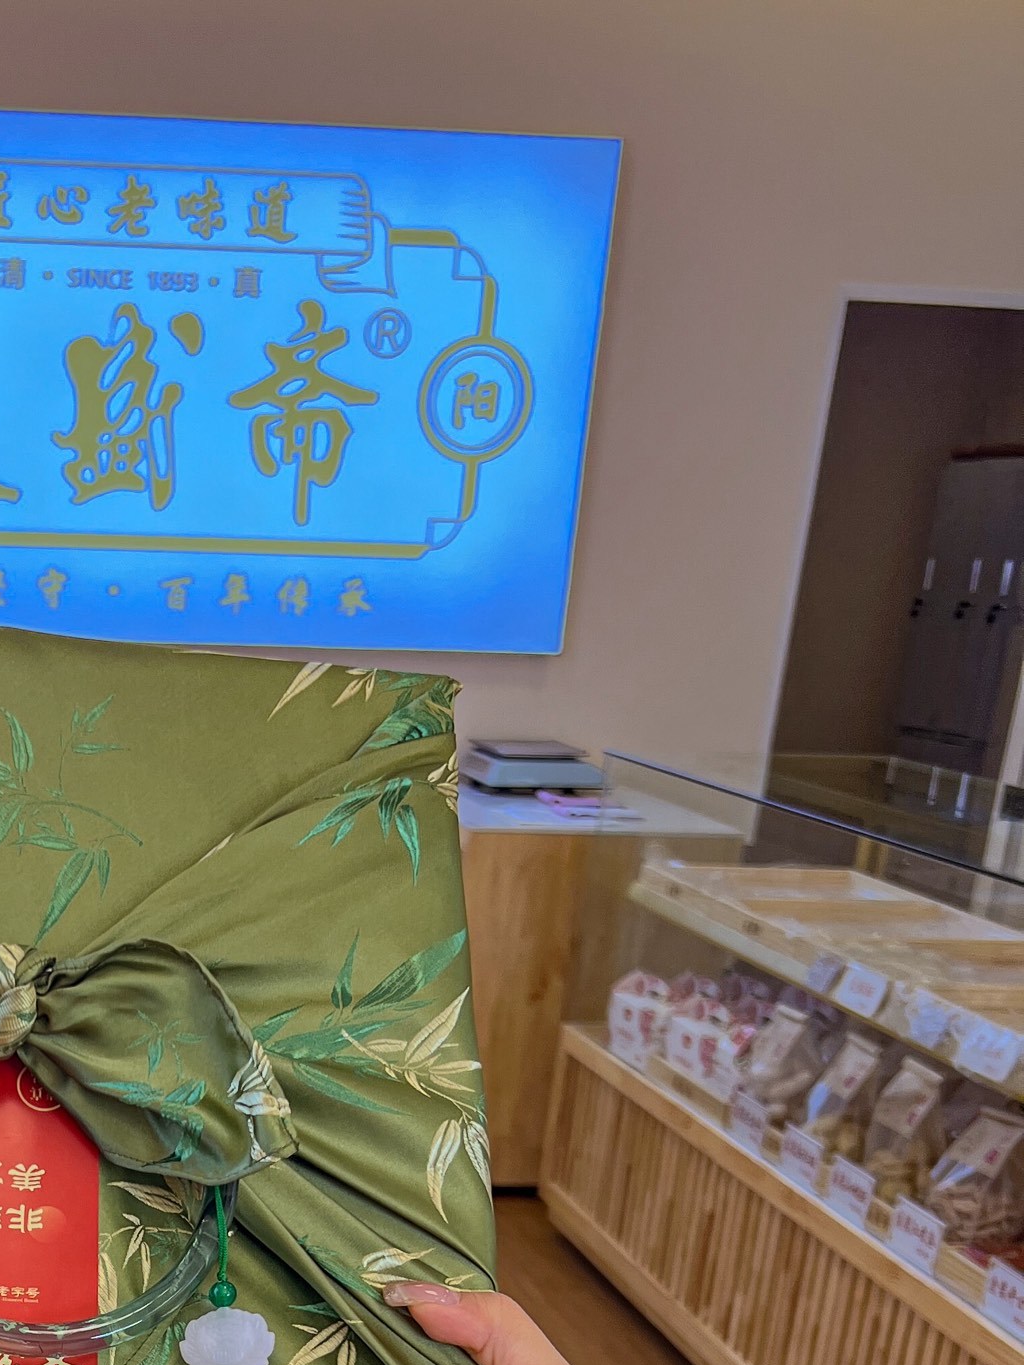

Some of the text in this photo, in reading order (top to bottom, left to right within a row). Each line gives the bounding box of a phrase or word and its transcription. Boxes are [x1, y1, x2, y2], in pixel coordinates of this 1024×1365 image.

[65, 267, 134, 291] SINCE
[147, 270, 200, 292] 1893
[451, 372, 501, 429] 阳
